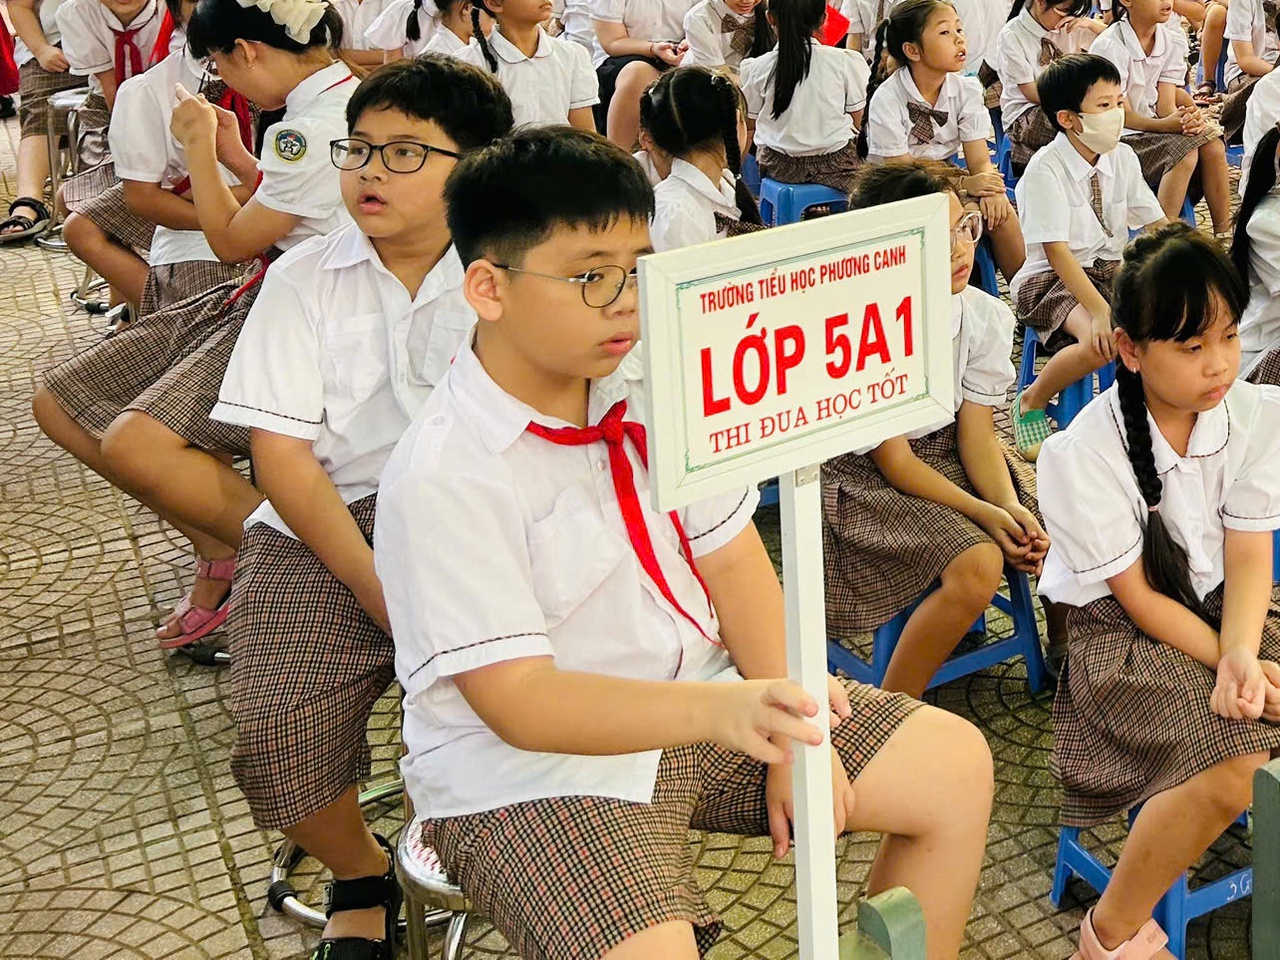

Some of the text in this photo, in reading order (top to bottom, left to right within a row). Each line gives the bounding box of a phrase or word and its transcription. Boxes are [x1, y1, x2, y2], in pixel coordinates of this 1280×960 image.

[757, 267, 786, 298] TIỂU
[790, 268, 816, 294] HỌC
[819, 256, 870, 284] PHƯƠNG
[873, 244, 906, 272] CANH
[699, 295, 914, 418] LỚP 5A1
[709, 367, 909, 454] THI ĐUA HỌC TỐT
